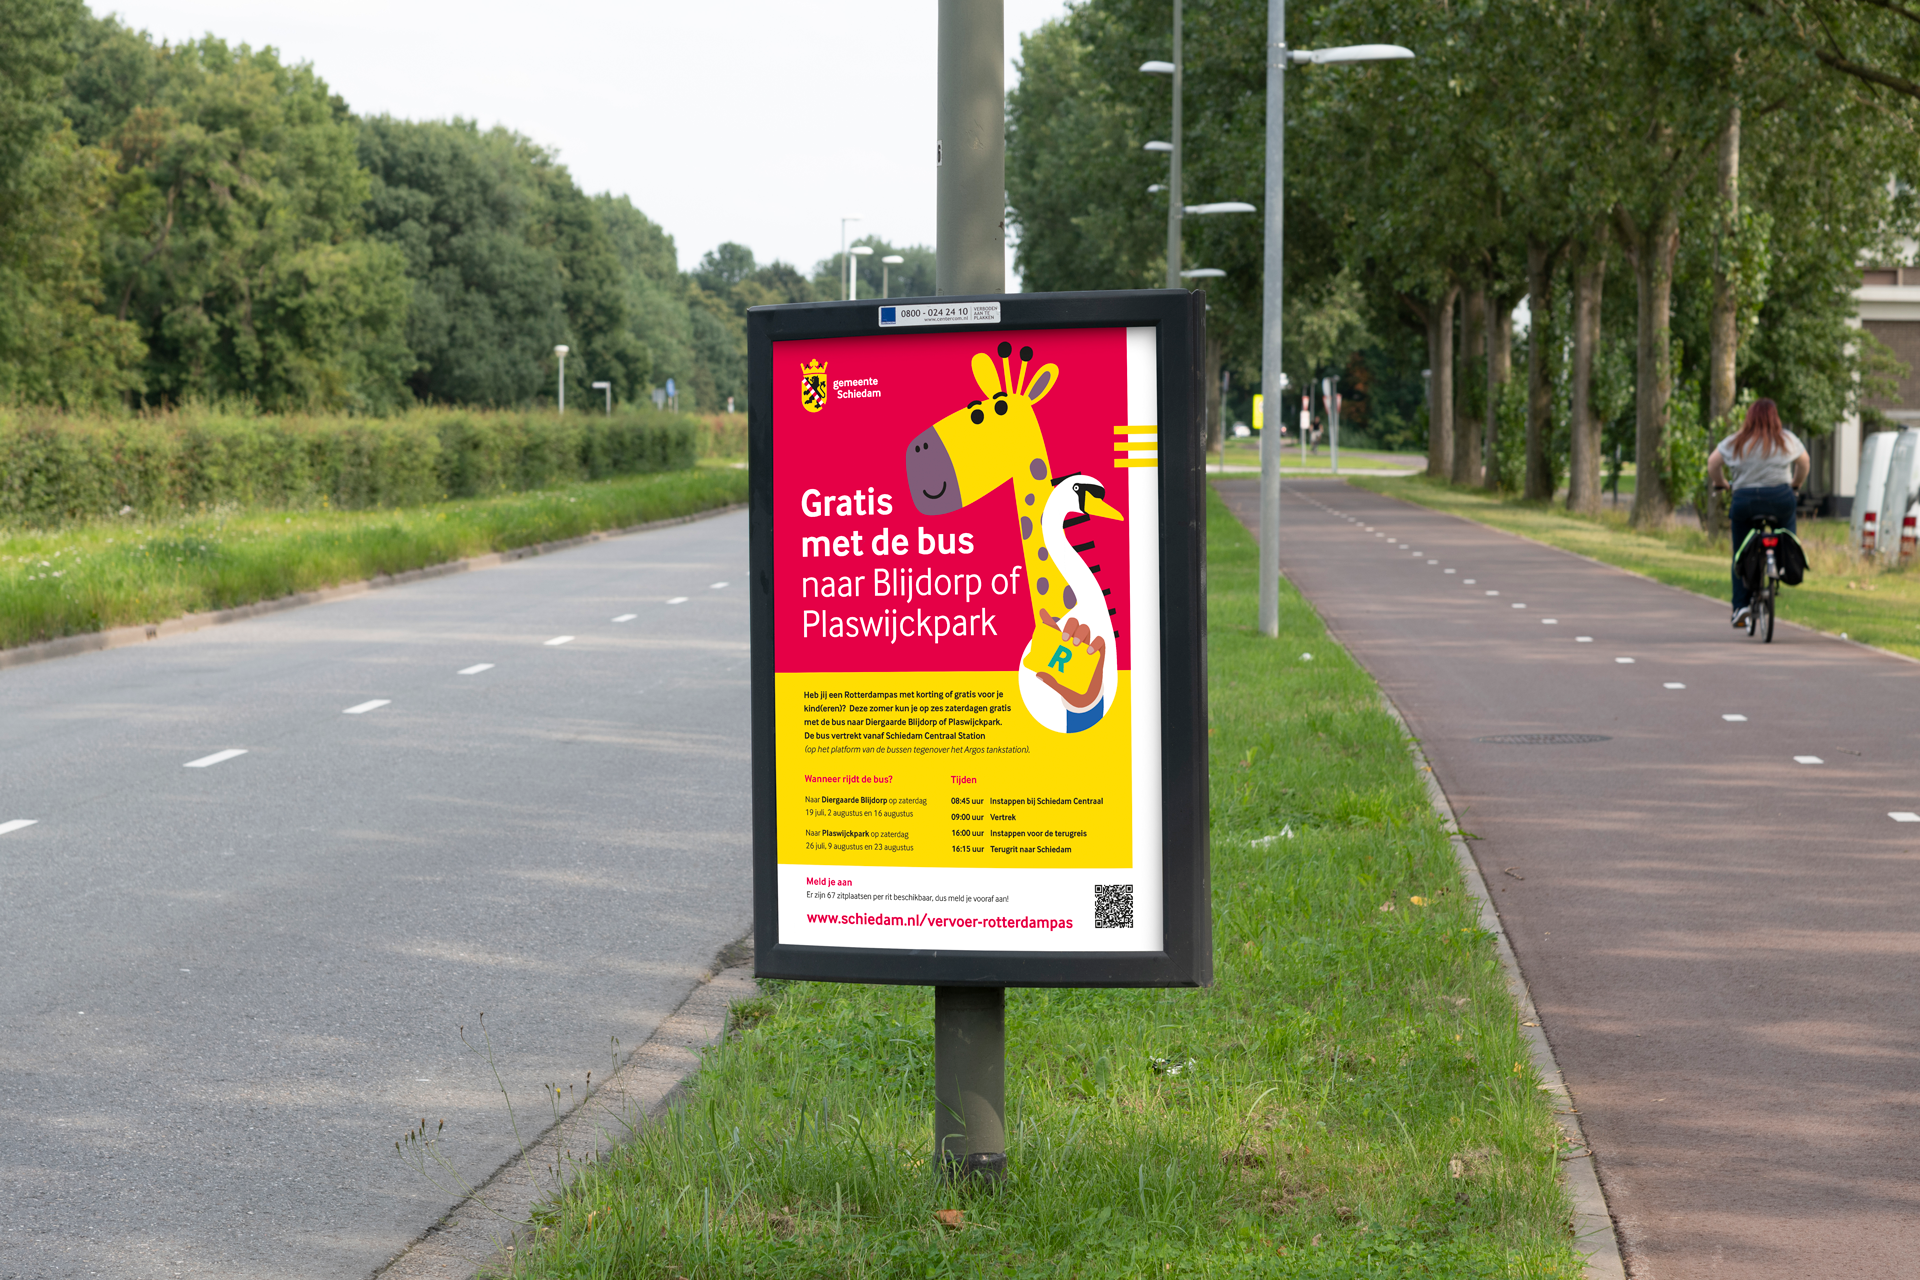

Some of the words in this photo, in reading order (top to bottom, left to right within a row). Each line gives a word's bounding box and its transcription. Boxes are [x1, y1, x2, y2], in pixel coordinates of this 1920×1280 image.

[901, 309, 921, 318] 0800
[928, 308, 943, 316] 024
[833, 378, 878, 388] gemeente
[836, 388, 881, 398] Schiedam
[802, 487, 892, 517] Gratis
[803, 531, 863, 557] met
[872, 528, 908, 555] de
[918, 527, 974, 554] bus
[803, 576, 865, 597] naar
[875, 568, 981, 603] Blijdorp
[992, 566, 1022, 594] of
[804, 608, 997, 644] Plaswijckpark
[1048, 644, 1073, 673] R
[844, 690, 898, 700] Rotterdampas
[916, 690, 944, 700] korting
[944, 690, 954, 698] of
[954, 690, 977, 700] gratis
[996, 690, 1004, 700] je
[803, 704, 847, 713] kind(eren)?
[849, 704, 868, 712] Deze
[894, 704, 910, 712] kun
[910, 704, 918, 714] je
[919, 705, 930, 714] op
[944, 704, 988, 714] zaterdagen
[989, 704, 1012, 714] gratis
[820, 718, 830, 726] de
[831, 718, 846, 726] bus
[865, 718, 907, 728] Diergaarde
[908, 718, 938, 728] Blijdorp
[938, 717, 948, 726] of
[948, 718, 1003, 728] Plaswijckpark.
[804, 731, 815, 740] De
[815, 732, 830, 740] bus
[830, 732, 862, 740] vertrekt
[862, 731, 885, 740] vanaf
[885, 731, 923, 740] Schiedam
[924, 731, 957, 740] Centraal
[958, 731, 986, 740] Station
[804, 744, 817, 754] (op
[817, 746, 830, 754] het
[830, 745, 861, 754] platform
[876, 746, 886, 754] de
[886, 746, 912, 754] bussen
[913, 746, 950, 756] tegenover
[950, 746, 963, 754] het
[963, 746, 985, 756] Argos
[986, 745, 1030, 754] tankstation).
[804, 774, 842, 783] Wanneer
[842, 774, 860, 785] rijdt
[861, 774, 872, 784] de
[873, 774, 894, 784] bus?
[950, 775, 977, 786] Tijden
[821, 795, 860, 806] Diergaarde
[860, 796, 888, 806] Blijdorp
[898, 798, 928, 806] zaterdag
[950, 797, 971, 805] 08:45
[990, 797, 1026, 806] Instappen
[1026, 797, 1036, 806] bij
[1072, 797, 1104, 805] Centraal
[814, 808, 826, 818] juli,
[827, 808, 832, 816] 2
[832, 810, 863, 818] augustus
[884, 810, 914, 819] augustus
[822, 829, 870, 839] Plaswijckpark
[880, 831, 910, 840] zaterdag
[990, 829, 1026, 839] Instappen
[1054, 829, 1088, 839] terugreis
[806, 842, 815, 850] 26
[815, 842, 827, 850] juli,
[833, 844, 864, 852] augustus
[874, 843, 883, 851] 23
[884, 844, 914, 853] augustus
[990, 845, 1018, 855] Terugrit
[1036, 845, 1072, 854] Schiedam
[806, 876, 827, 886] Meld
[827, 877, 836, 888] je
[806, 890, 814, 898] Er
[814, 891, 826, 900] zijn
[836, 892, 872, 901] zitplaatsen
[893, 893, 934, 902] beschikbaar,
[966, 895, 972, 904] je
[972, 894, 994, 902] vooraf
[806, 912, 1074, 932] www.schiedam.nl/vervoer-rotterdampas
